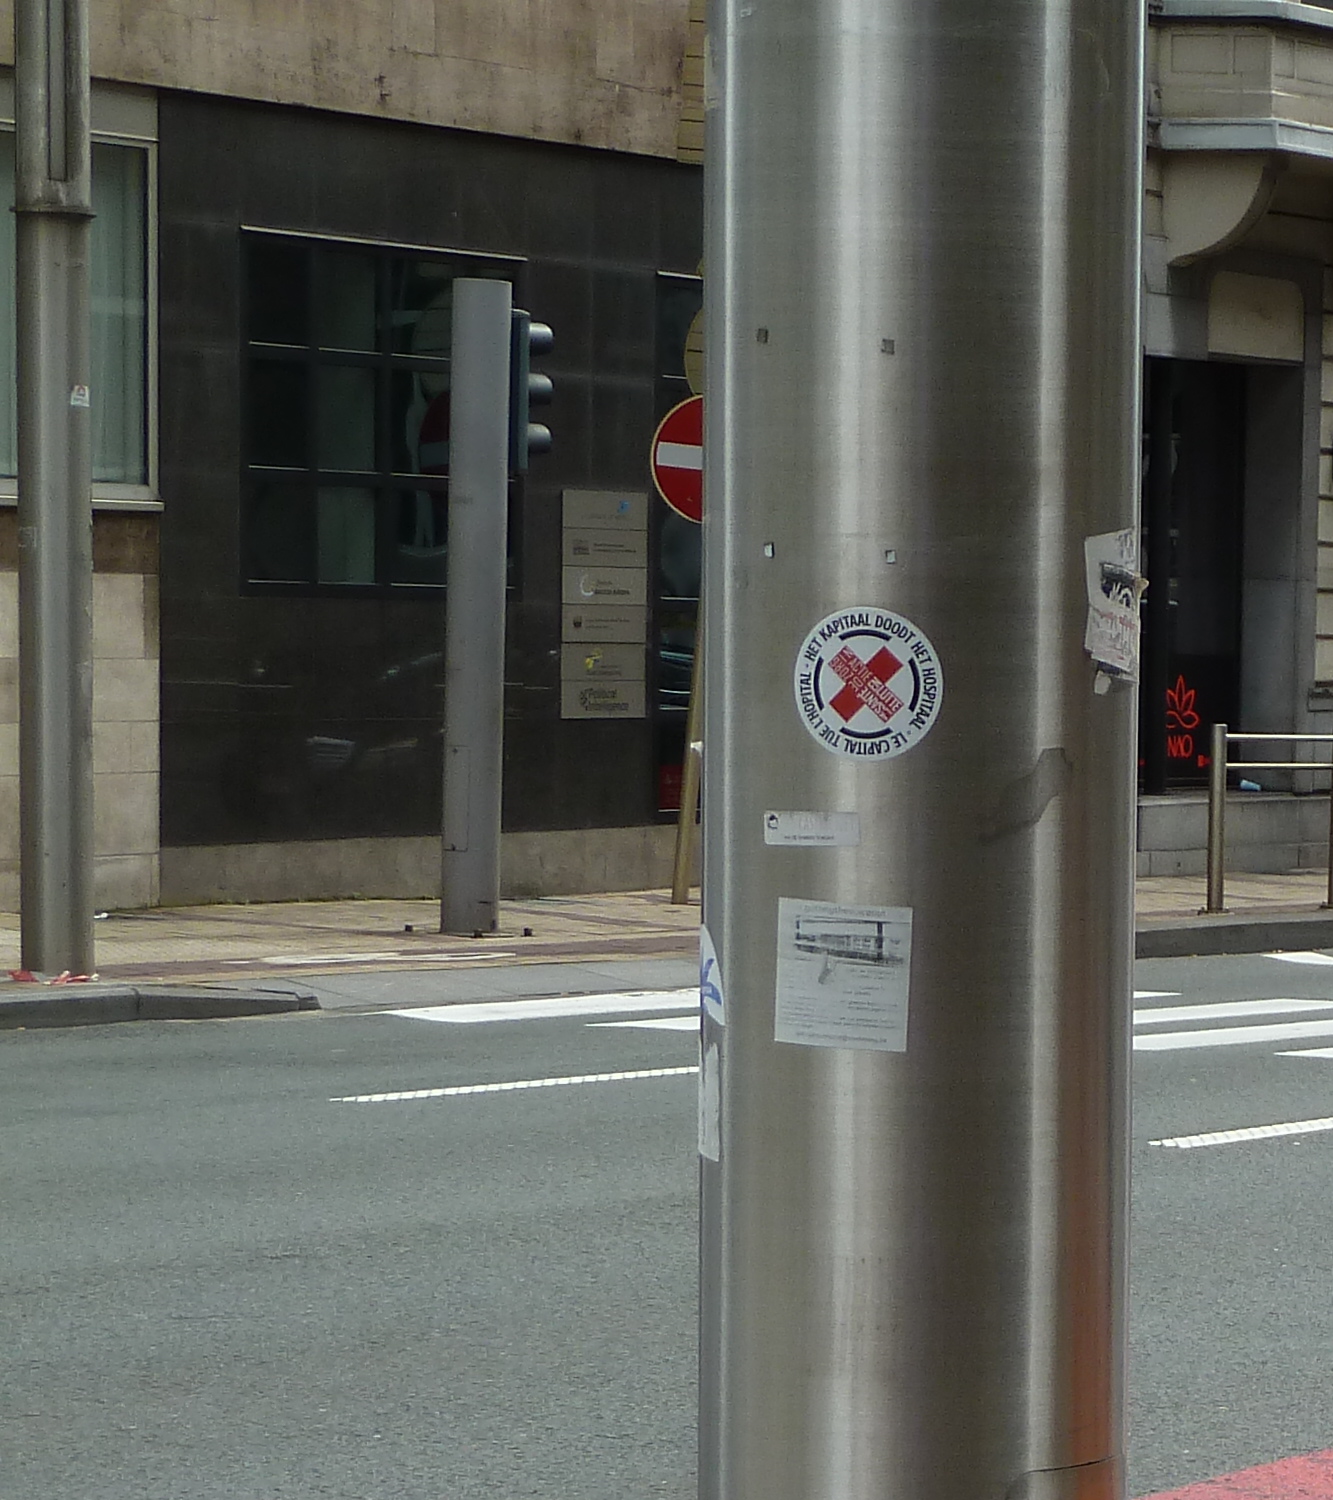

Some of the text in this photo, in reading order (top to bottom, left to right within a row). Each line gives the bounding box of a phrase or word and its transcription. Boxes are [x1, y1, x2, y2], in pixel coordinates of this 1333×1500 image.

[804, 613, 937, 731] HET KAPITAAL DOODT HET HOSPITAAL
[874, 684, 902, 712] LUTTE
[818, 725, 840, 748] TUE
[843, 738, 890, 756] CAPITAL
[894, 731, 908, 748] LE
